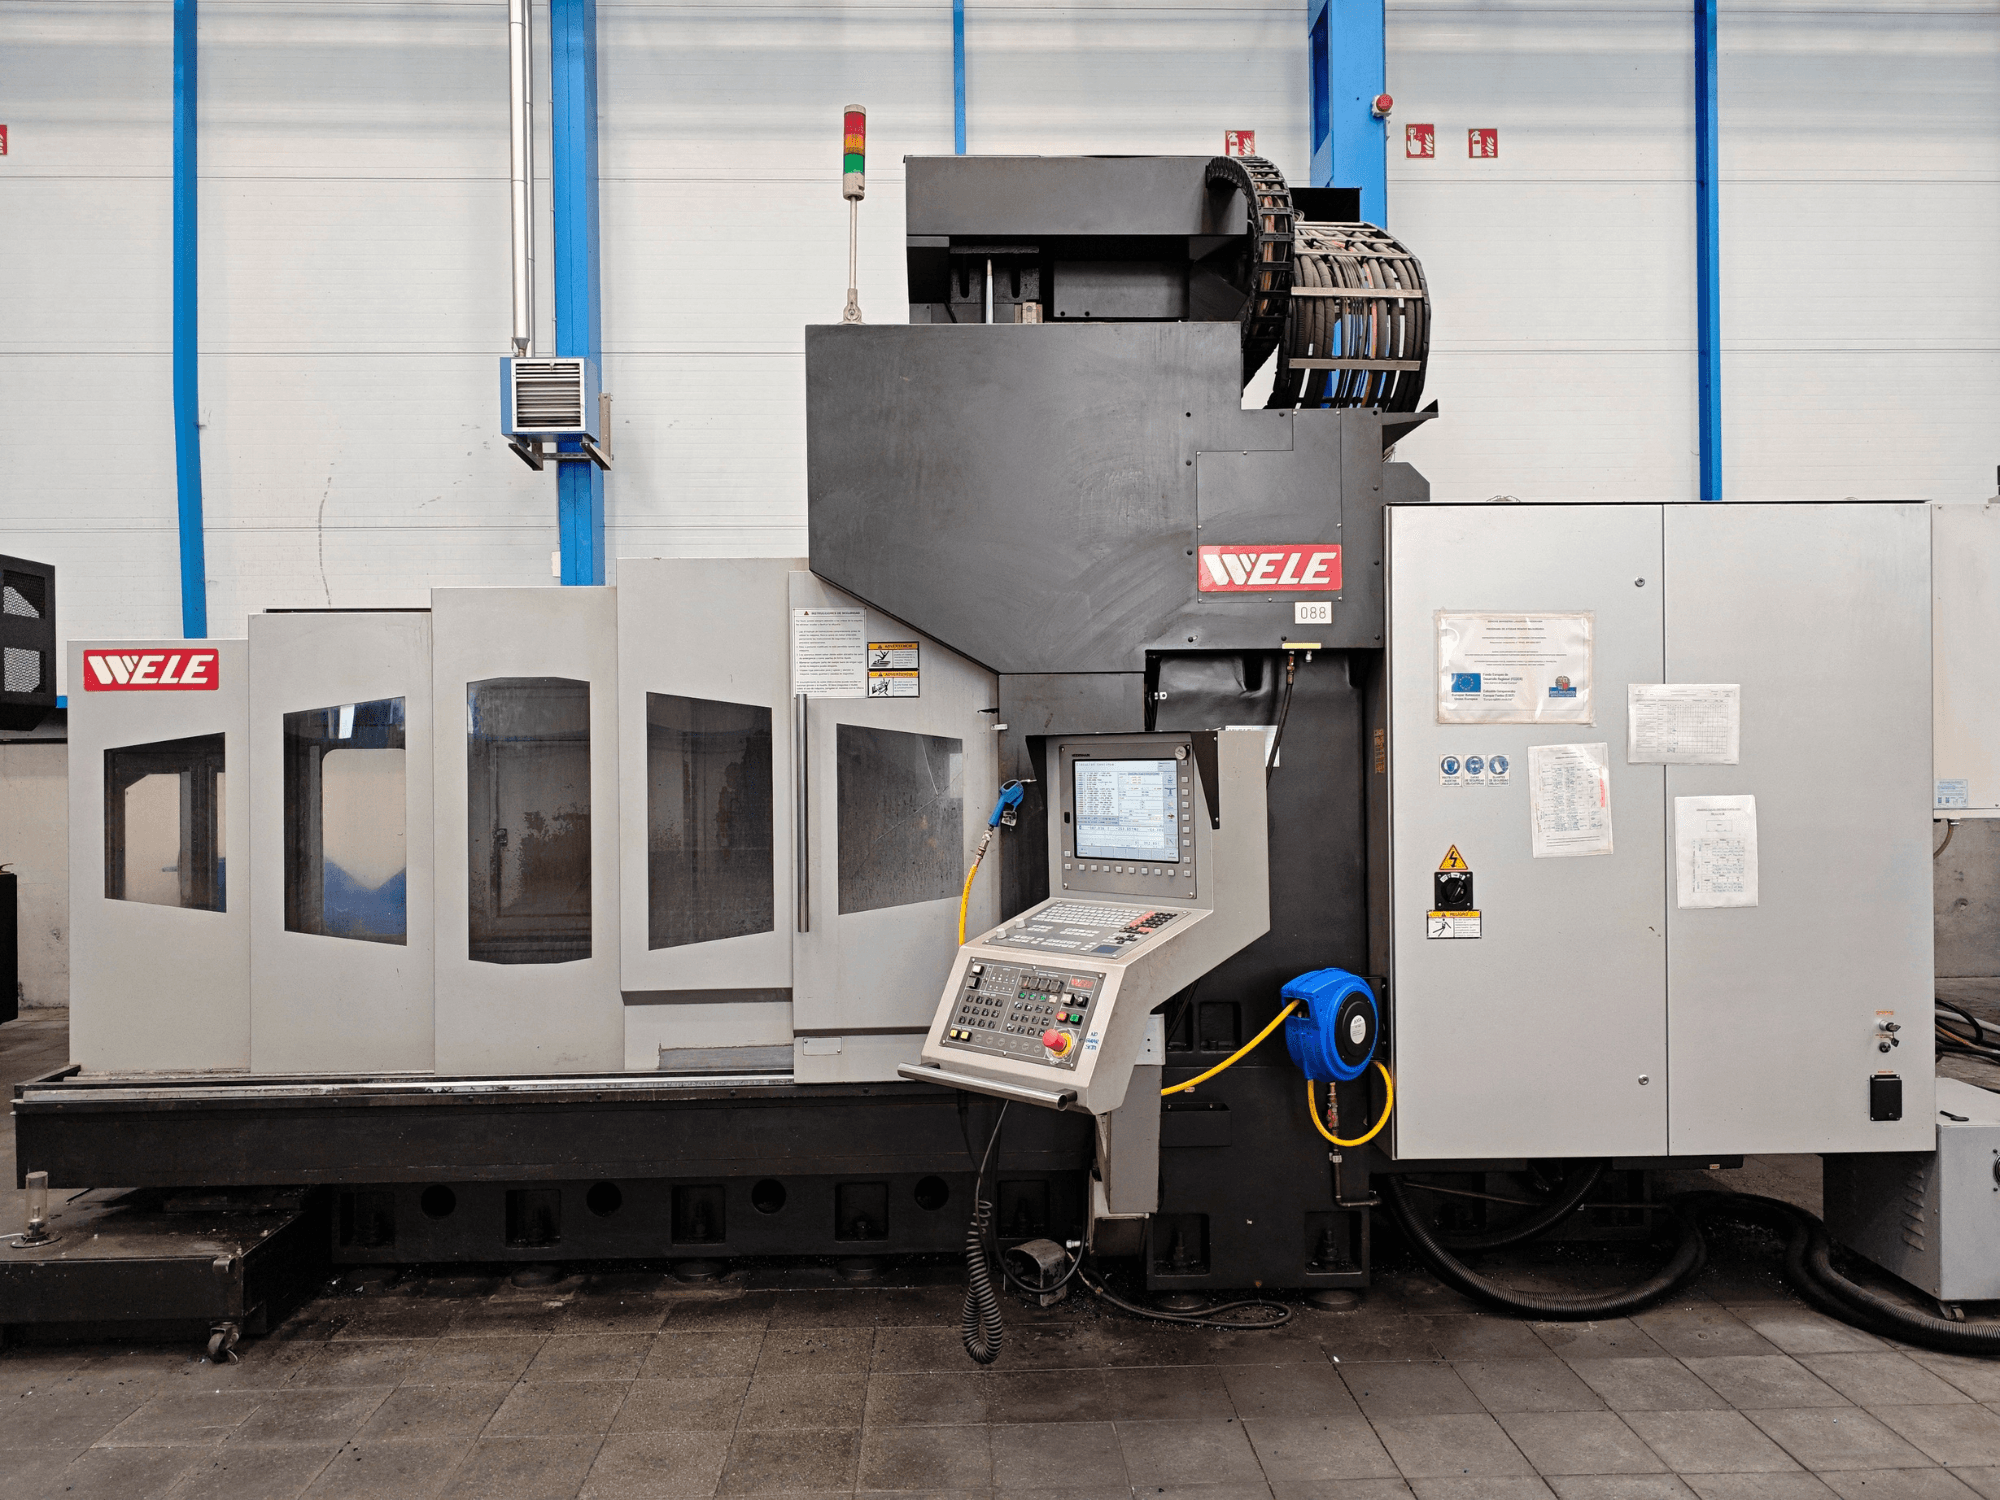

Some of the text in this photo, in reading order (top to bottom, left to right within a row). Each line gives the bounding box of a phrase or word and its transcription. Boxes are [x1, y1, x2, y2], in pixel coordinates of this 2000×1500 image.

[1203, 552, 1337, 586] WELE
[1300, 606, 1327, 620] 088
[87, 654, 215, 685] WELE
